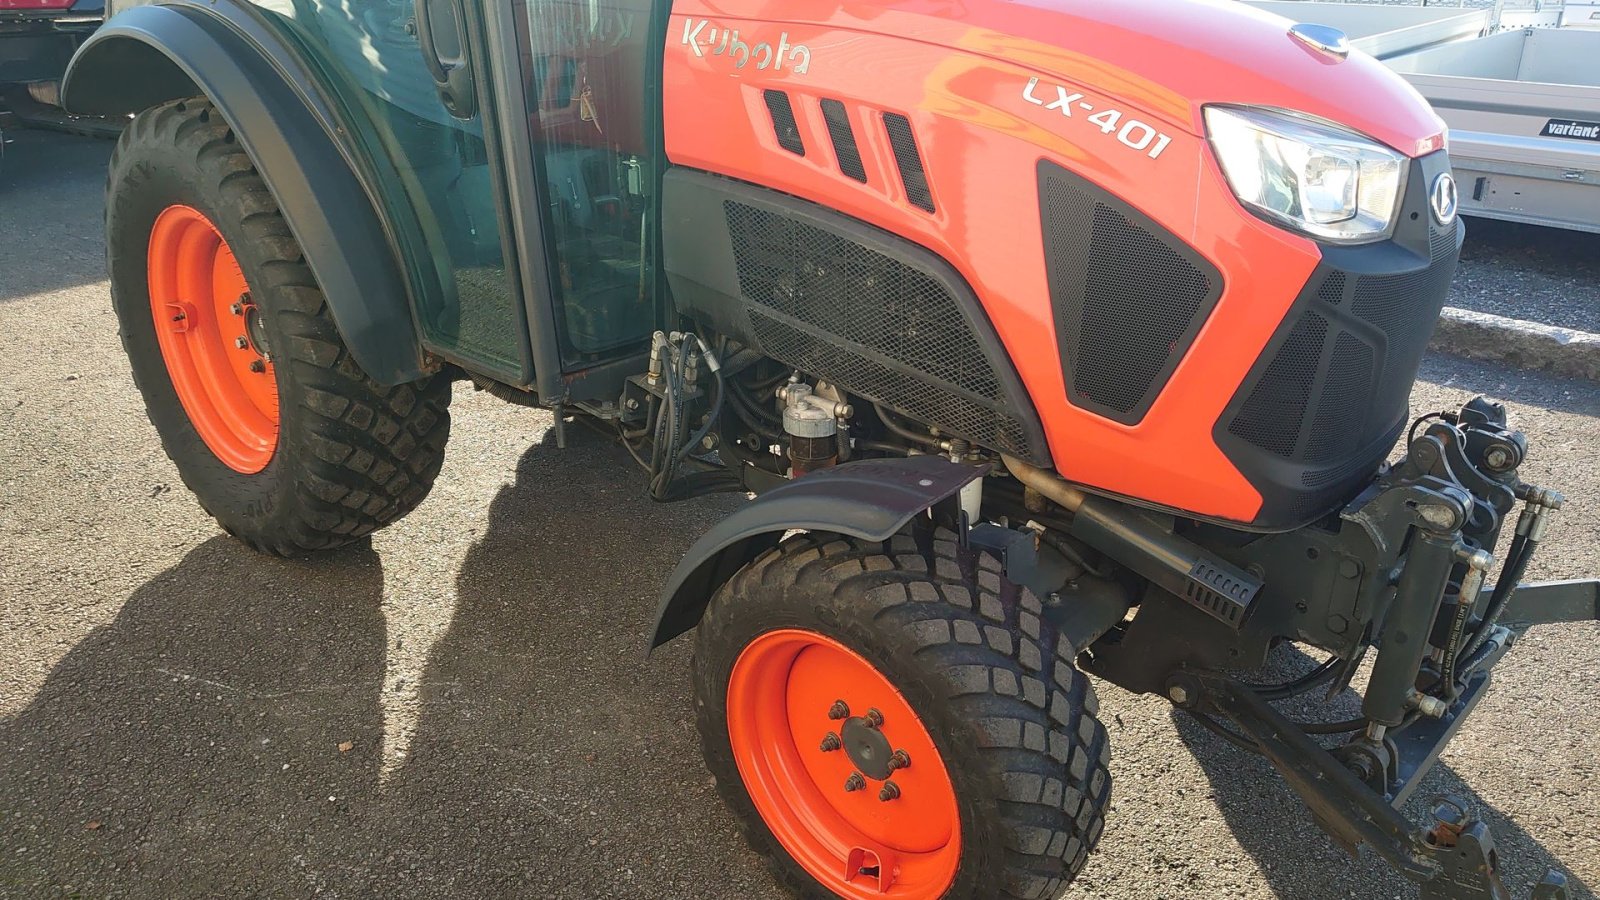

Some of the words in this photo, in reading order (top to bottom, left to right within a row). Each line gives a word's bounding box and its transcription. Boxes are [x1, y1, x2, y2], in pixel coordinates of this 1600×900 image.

[681, 18, 812, 74] Kubota
[1022, 76, 1173, 160] LX-401
[1548, 122, 1600, 138] variant
